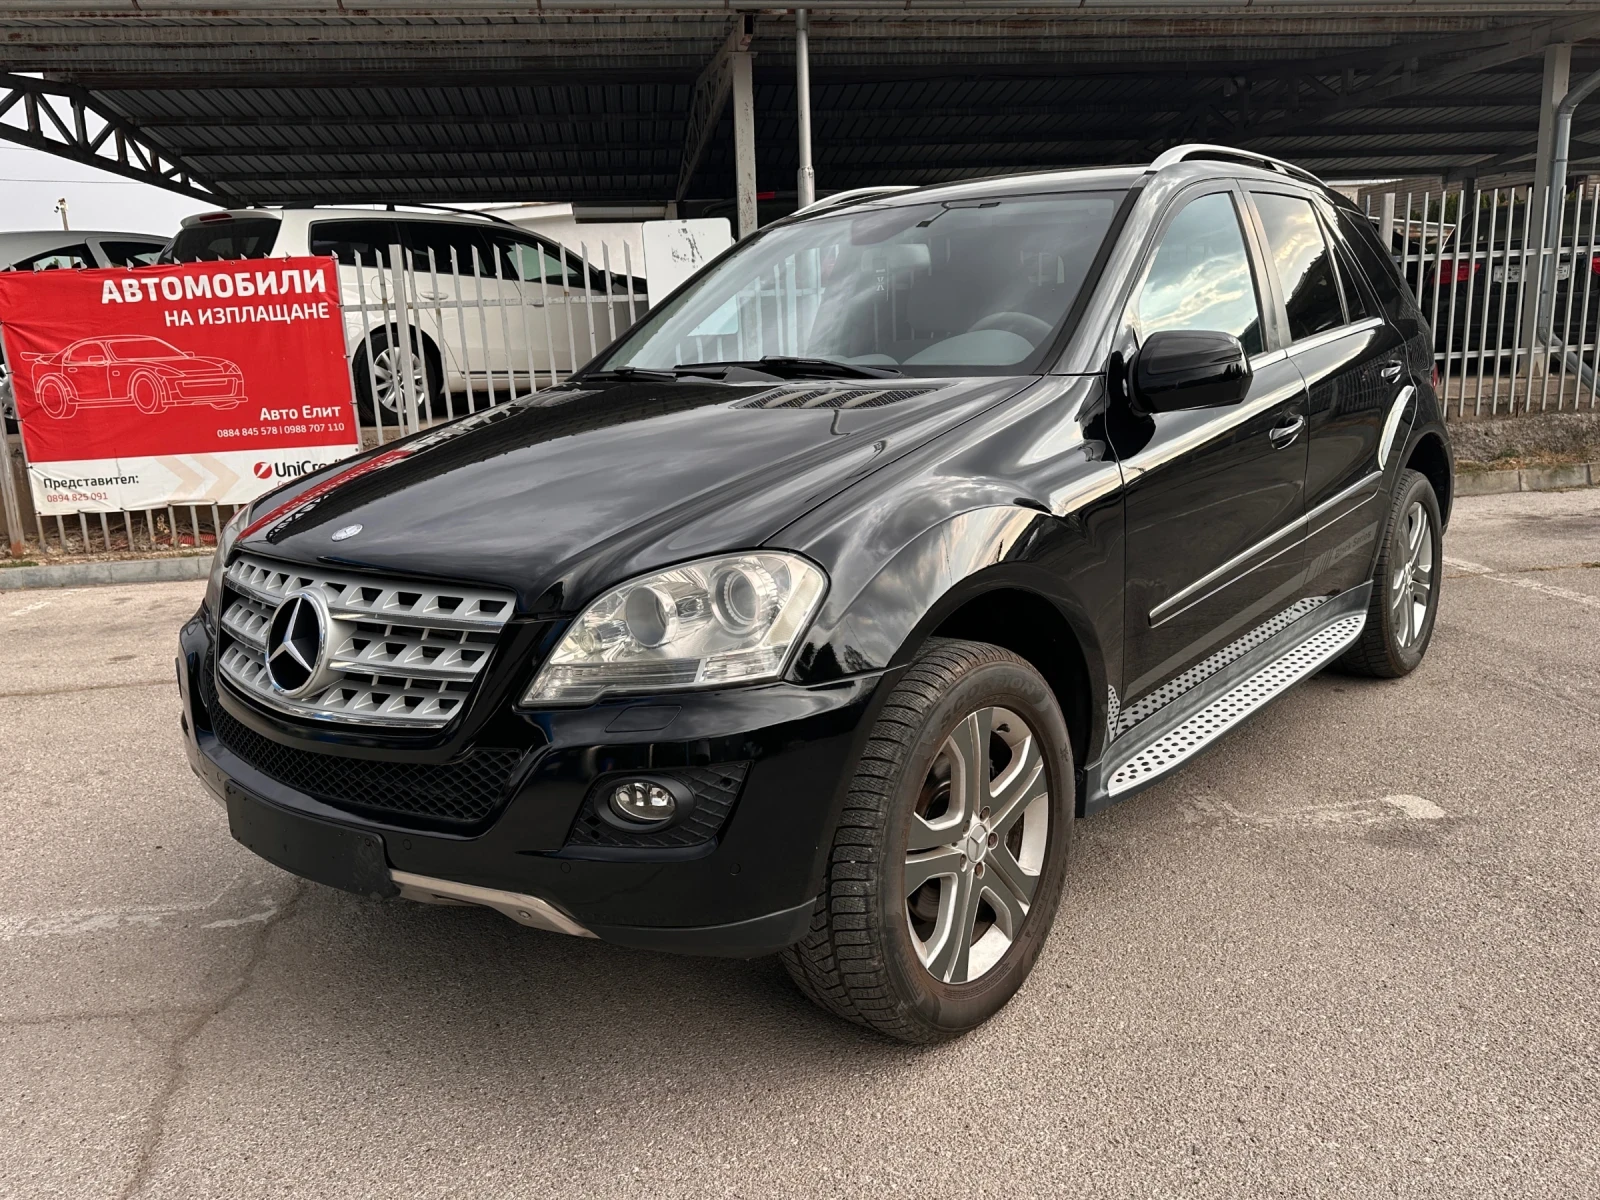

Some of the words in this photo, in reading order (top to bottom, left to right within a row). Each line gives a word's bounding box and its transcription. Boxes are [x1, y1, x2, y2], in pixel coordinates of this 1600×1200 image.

[101, 268, 327, 304] АВТОМОБИЛИ
[164, 309, 195, 327] НА
[197, 302, 330, 324] ИЗПЛАЩАНЕ
[259, 407, 299, 421] Авто
[302, 405, 342, 419] Елит
[216, 428, 240, 438] 0884
[241, 427, 259, 437] 845
[260, 426, 278, 436] 578
[284, 424, 307, 434] 0988
[308, 423, 326, 433] 707
[328, 422, 345, 432] 110
[43, 474, 140, 491] Представител:
[46, 494, 70, 503] 0894
[71, 493, 89, 502] 825
[90, 492, 108, 501] 091
